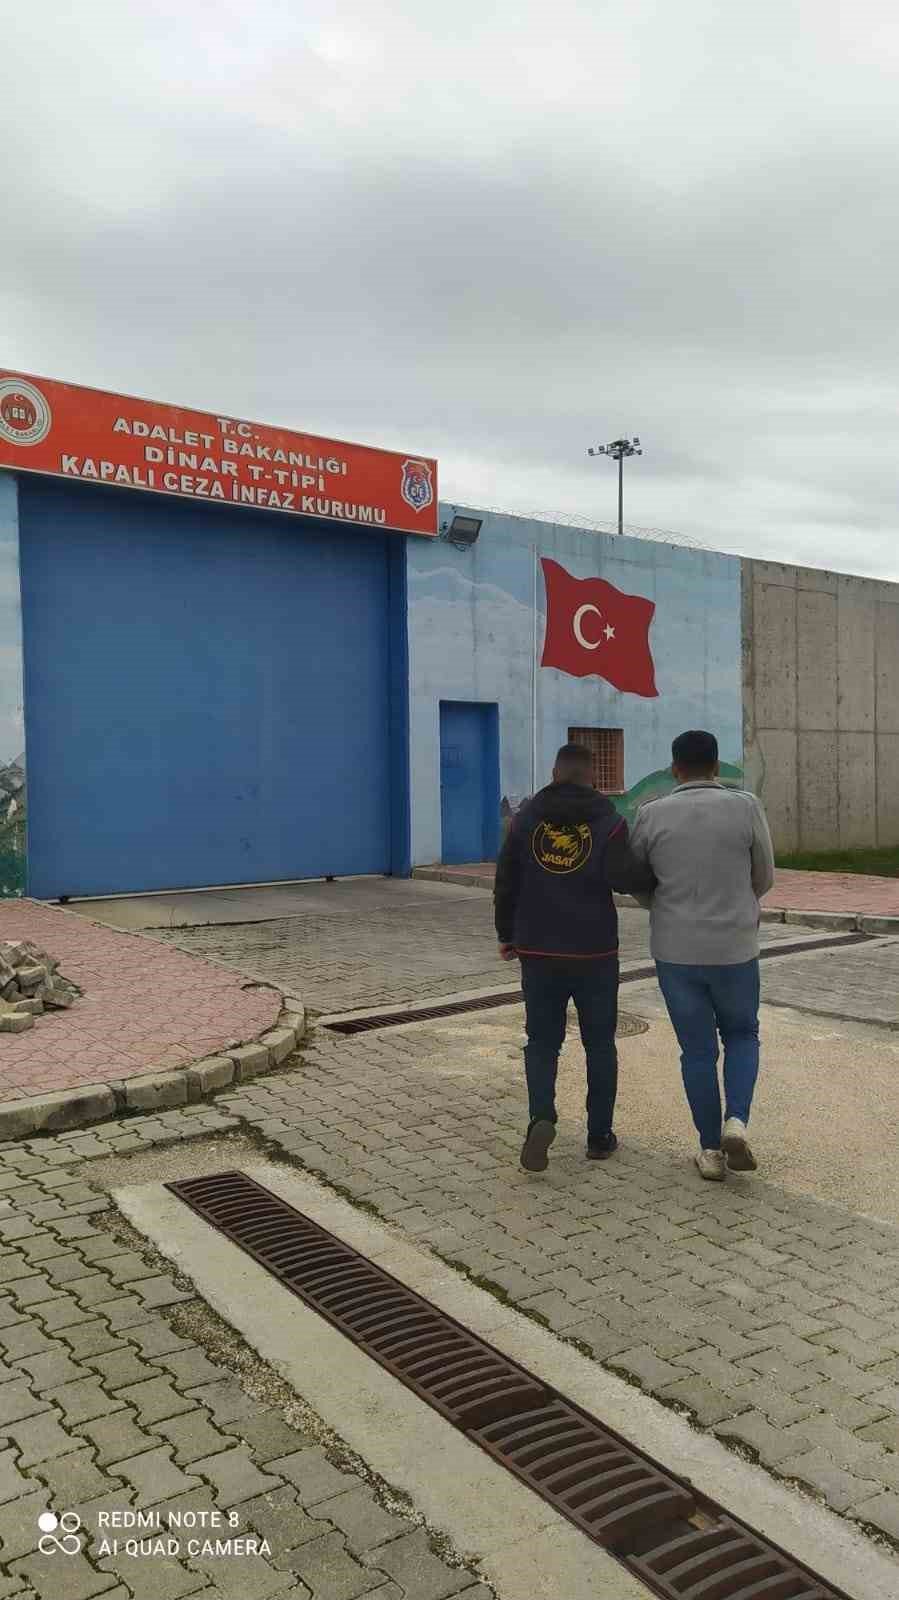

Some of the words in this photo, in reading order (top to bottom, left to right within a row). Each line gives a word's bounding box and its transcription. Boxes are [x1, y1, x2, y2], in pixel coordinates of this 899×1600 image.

[113, 416, 215, 449] ADALET
[223, 439, 347, 475] BAKANLIĞI
[217, 418, 260, 440] T.C.
[61, 454, 154, 488] KAPALI
[163, 472, 225, 499] CEZA
[232, 480, 295, 509] İNFAZ
[301, 495, 386, 523] KURUMU
[145, 446, 238, 477] DİNAR
[248, 464, 325, 492] T-TİPİ
[542, 853, 575, 868] JASAT
